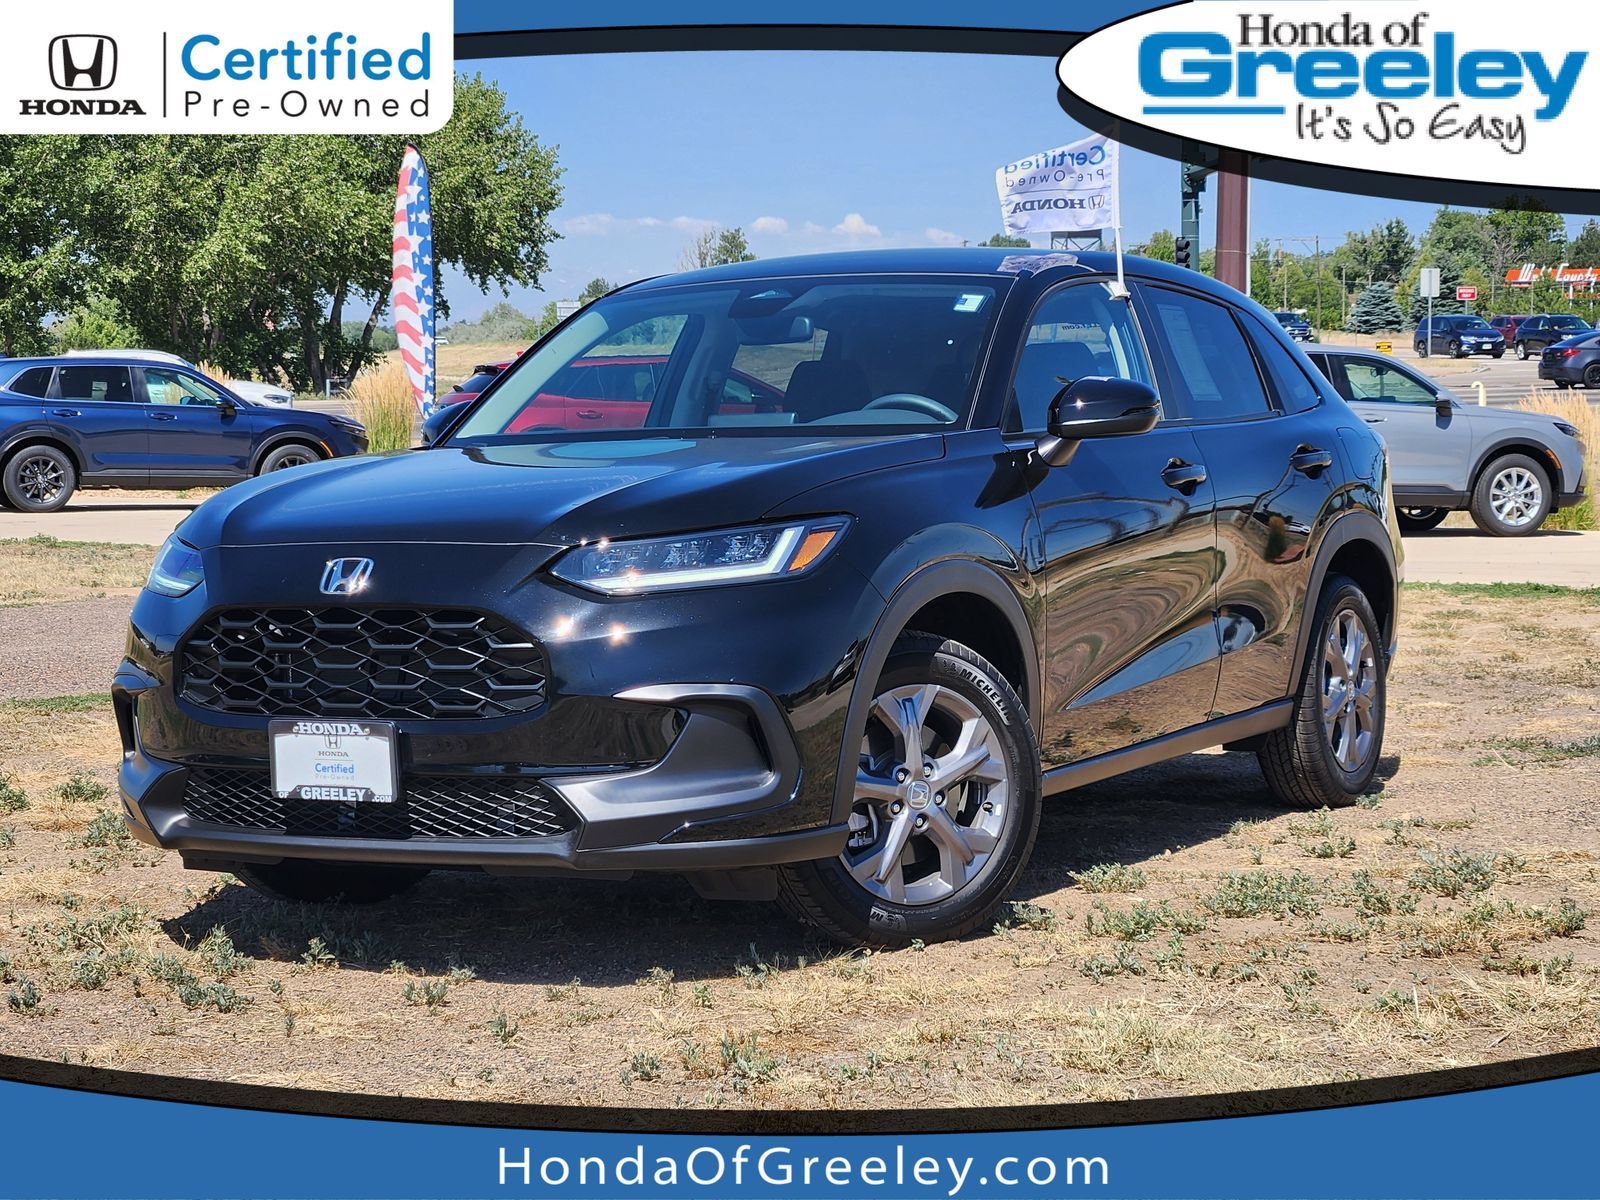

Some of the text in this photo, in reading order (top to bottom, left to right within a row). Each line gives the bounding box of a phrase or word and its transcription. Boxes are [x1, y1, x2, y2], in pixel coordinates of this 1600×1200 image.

[297, 722, 365, 736] HONDA
[315, 763, 354, 773] Certified
[301, 787, 366, 801] GREELEY
